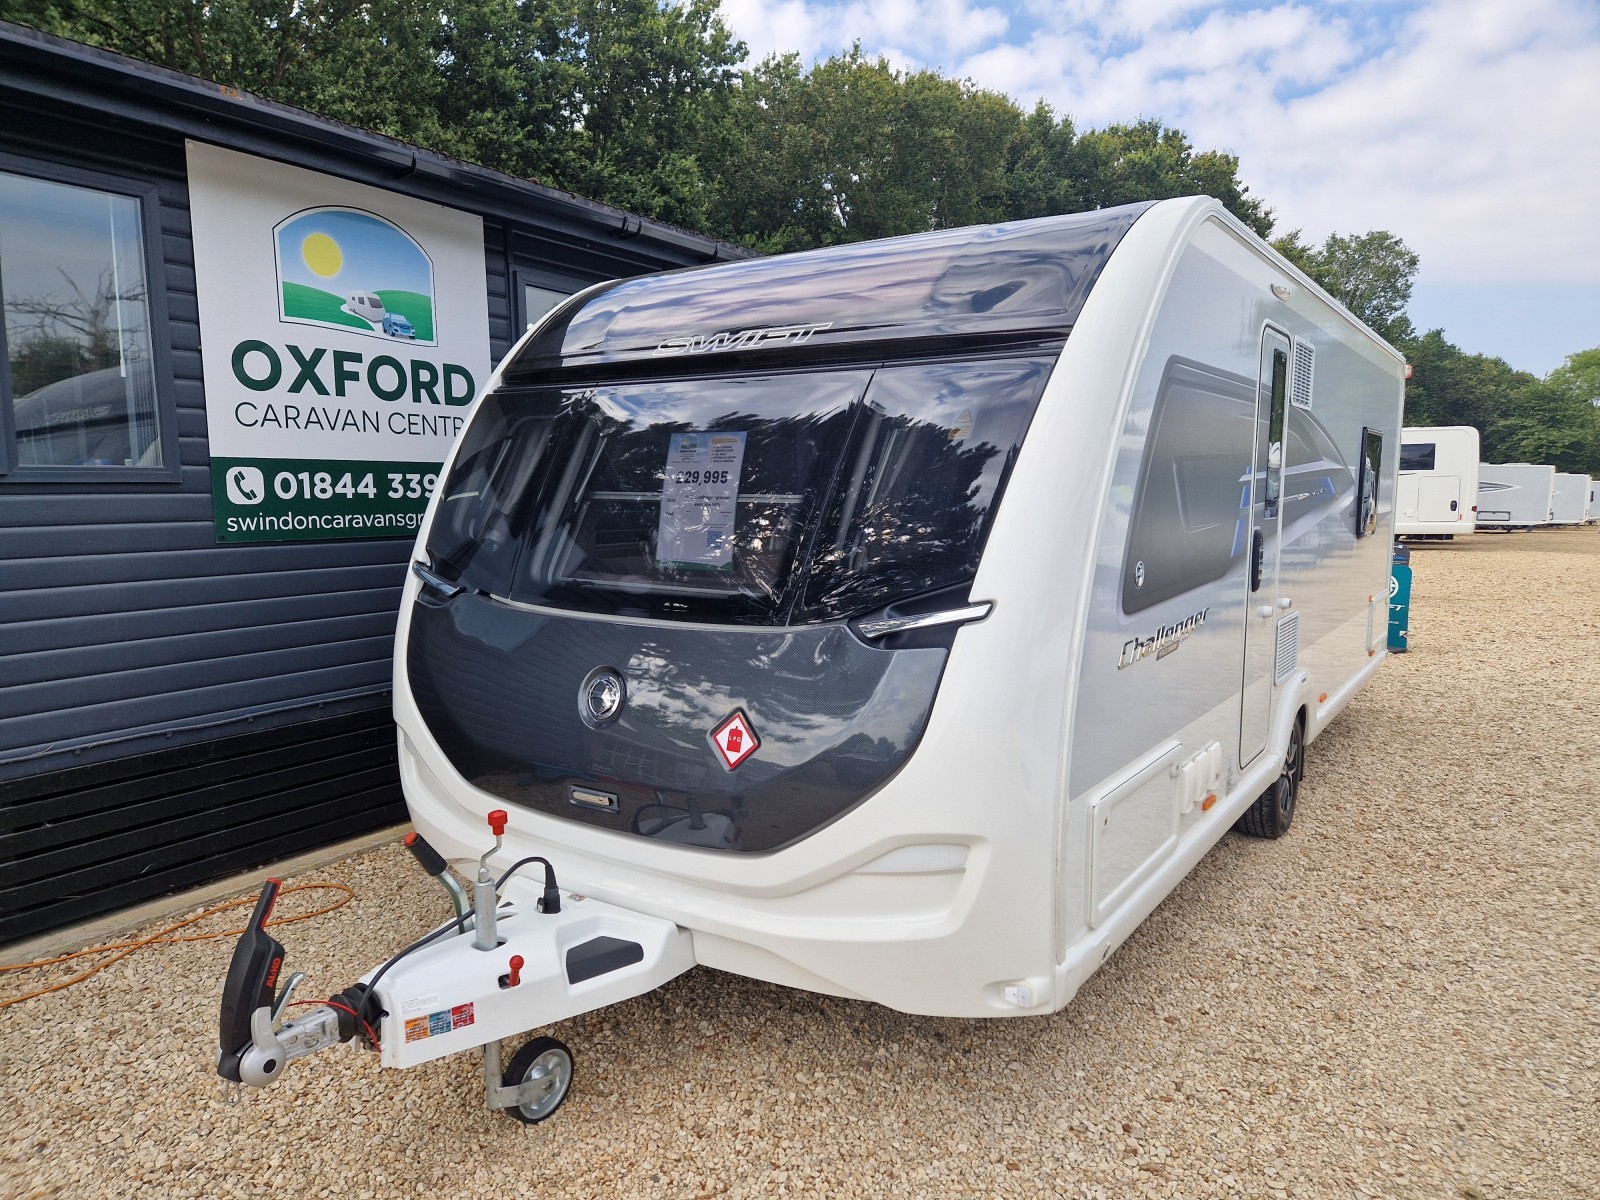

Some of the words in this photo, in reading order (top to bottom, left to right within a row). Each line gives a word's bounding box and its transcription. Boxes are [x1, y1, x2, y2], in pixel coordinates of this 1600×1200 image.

[653, 322, 834, 356] SWIFT
[231, 339, 476, 407] OXFORD
[234, 401, 380, 434] CARAVAN
[387, 411, 464, 438] CENTR
[273, 471, 378, 500] 01844
[387, 472, 438, 499] 339
[226, 510, 424, 532] swindoncaravansgr
[1117, 607, 1210, 671] Challenger
